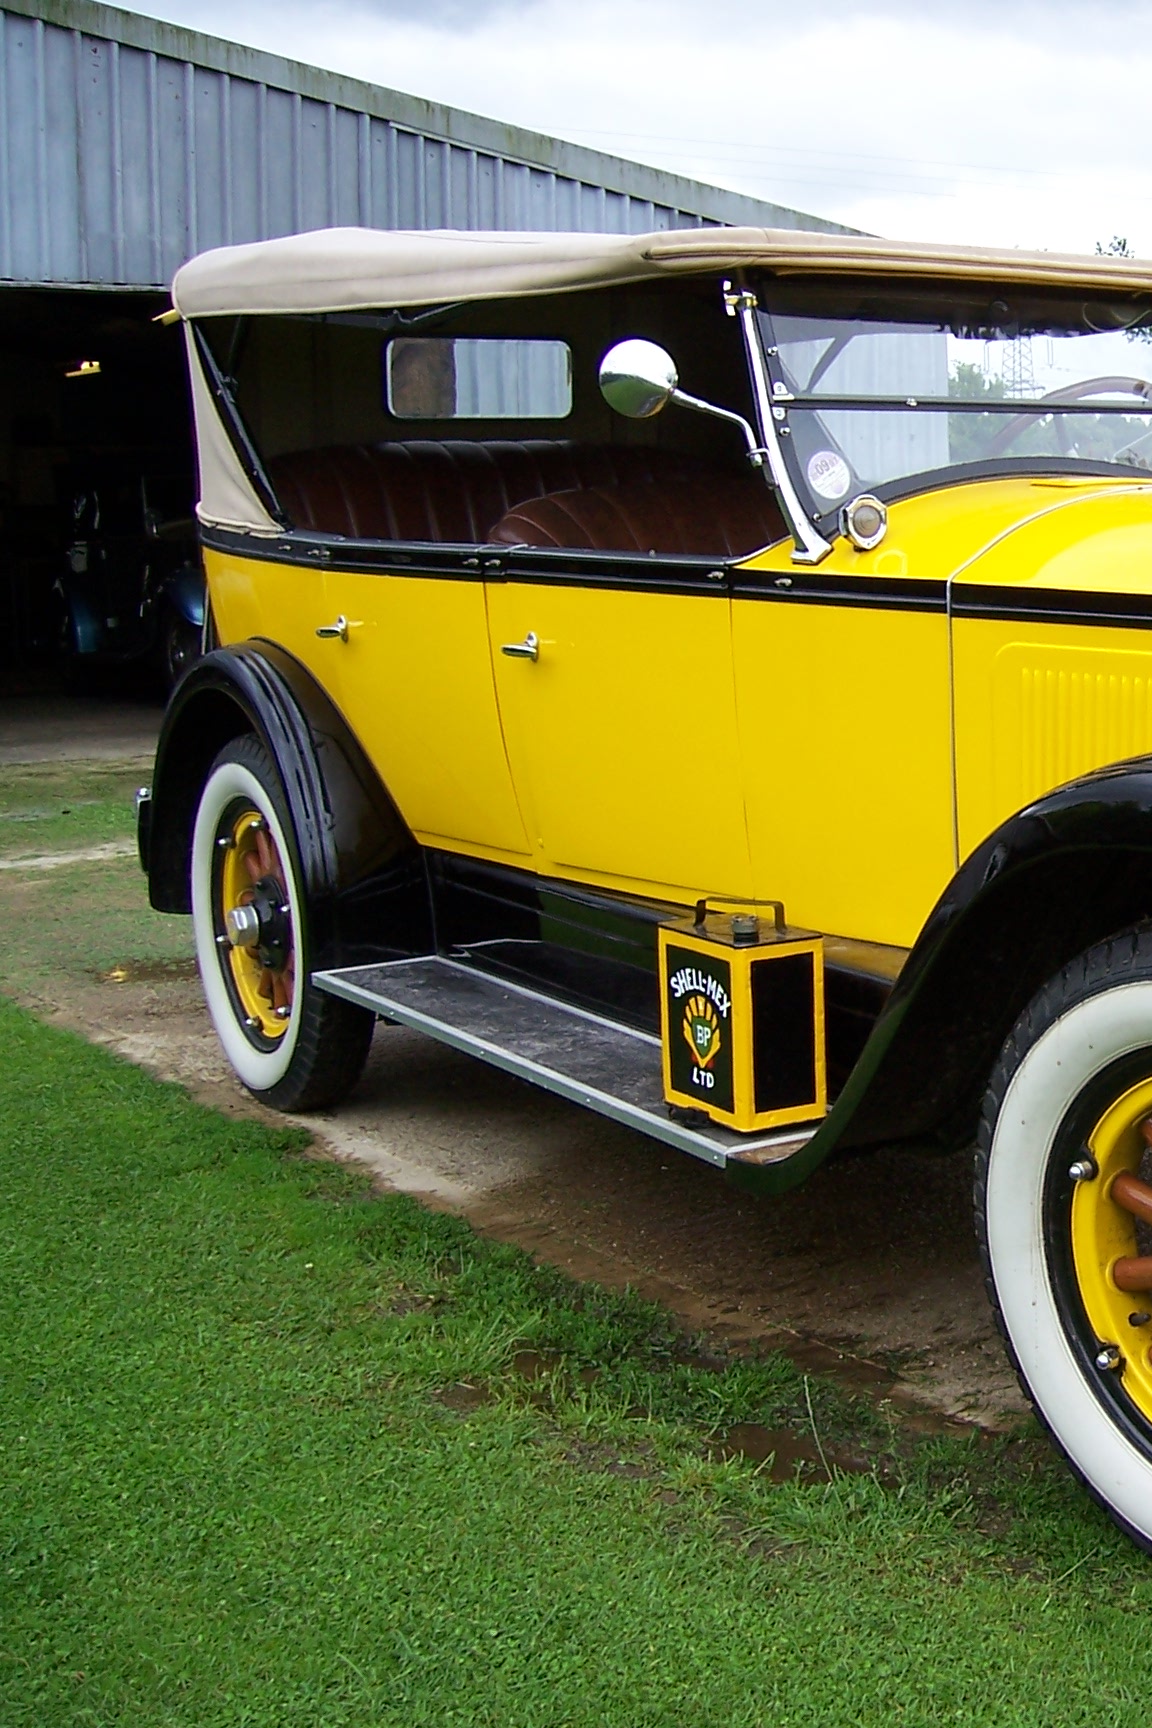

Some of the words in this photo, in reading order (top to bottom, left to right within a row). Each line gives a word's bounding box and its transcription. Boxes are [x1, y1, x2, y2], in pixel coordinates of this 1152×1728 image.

[670, 968, 731, 1018] SHELL-MEX
[696, 1024, 712, 1047] BP
[693, 1067, 714, 1088] LTD
